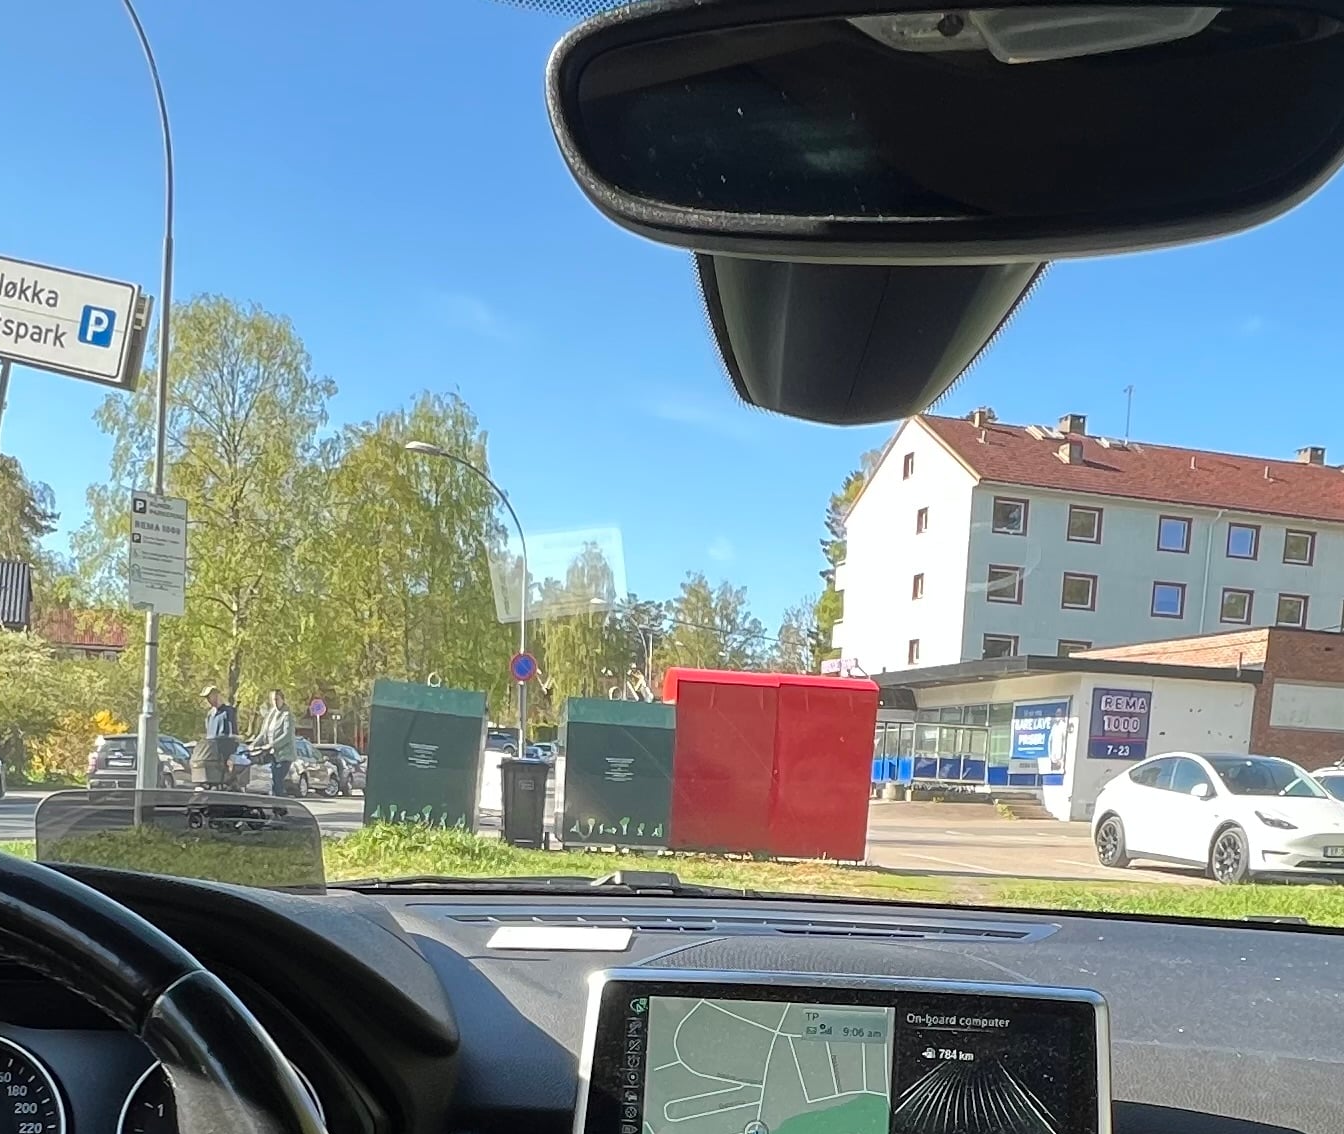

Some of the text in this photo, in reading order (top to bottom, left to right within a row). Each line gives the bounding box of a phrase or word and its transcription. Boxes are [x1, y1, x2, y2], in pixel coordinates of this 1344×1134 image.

[88, 312, 110, 342] P
[1101, 695, 1148, 714] REMA
[1103, 715, 1141, 733] 1000
[1107, 745, 1130, 756] 7-23
[805, 1012, 820, 1021] TP
[906, 1013, 1010, 1028] On-board computer
[842, 1026, 882, 1038] 9:06 am
[938, 1048, 975, 1061] 784 km
[7, 1085, 28, 1097] 180
[14, 1103, 38, 1114] 200
[157, 1103, 164, 1117] 1
[19, 1123, 42, 1134] 220
